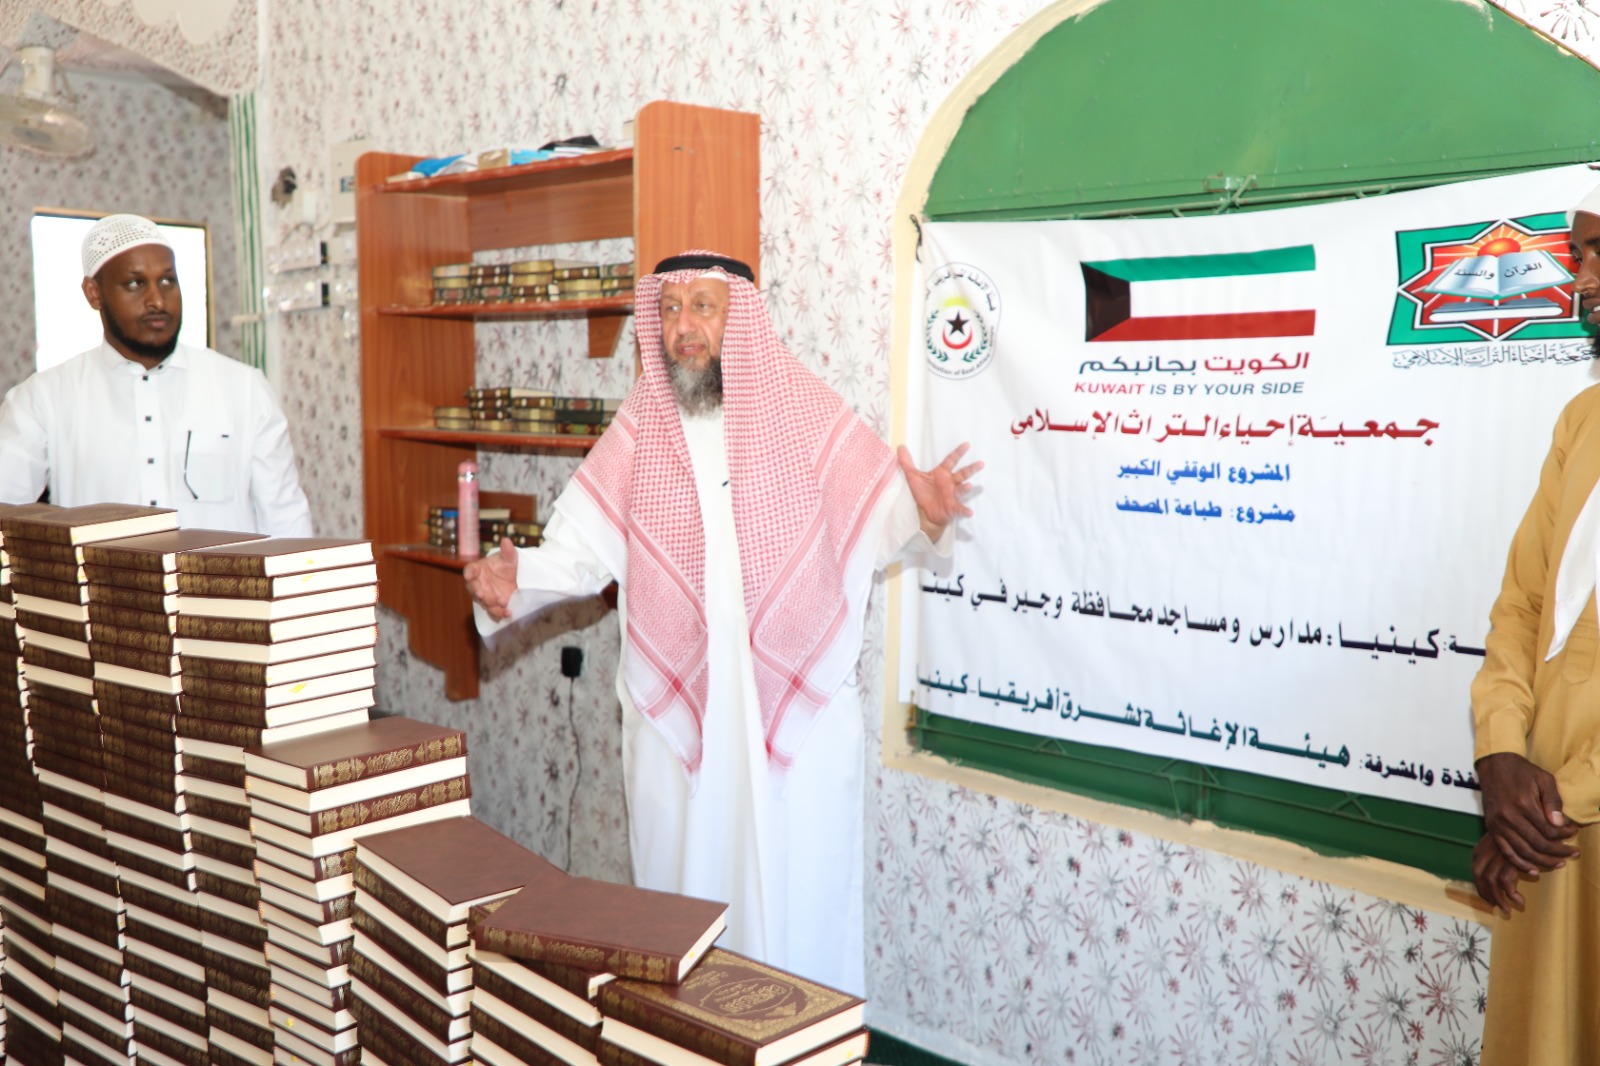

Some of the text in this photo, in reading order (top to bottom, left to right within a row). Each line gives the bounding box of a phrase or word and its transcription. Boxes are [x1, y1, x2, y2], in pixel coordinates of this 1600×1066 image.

[1078, 352, 1310, 376] الكويت بجانبكم
[1074, 381, 1304, 395] KUWAIT IS BY YOUR SIDE
[1116, 458, 1291, 485] المشروع الوقفي الكبير
[1116, 496, 1170, 515] المصحف
[1174, 498, 1223, 520] طباعة
[970, 577, 1007, 611] في
[1012, 588, 1063, 618] وجير
[1071, 590, 1153, 623] محافظة
[1157, 604, 1240, 643] ومساجد
[1144, 709, 1248, 750] الإغاثة
[1248, 727, 1351, 768] هيئة
